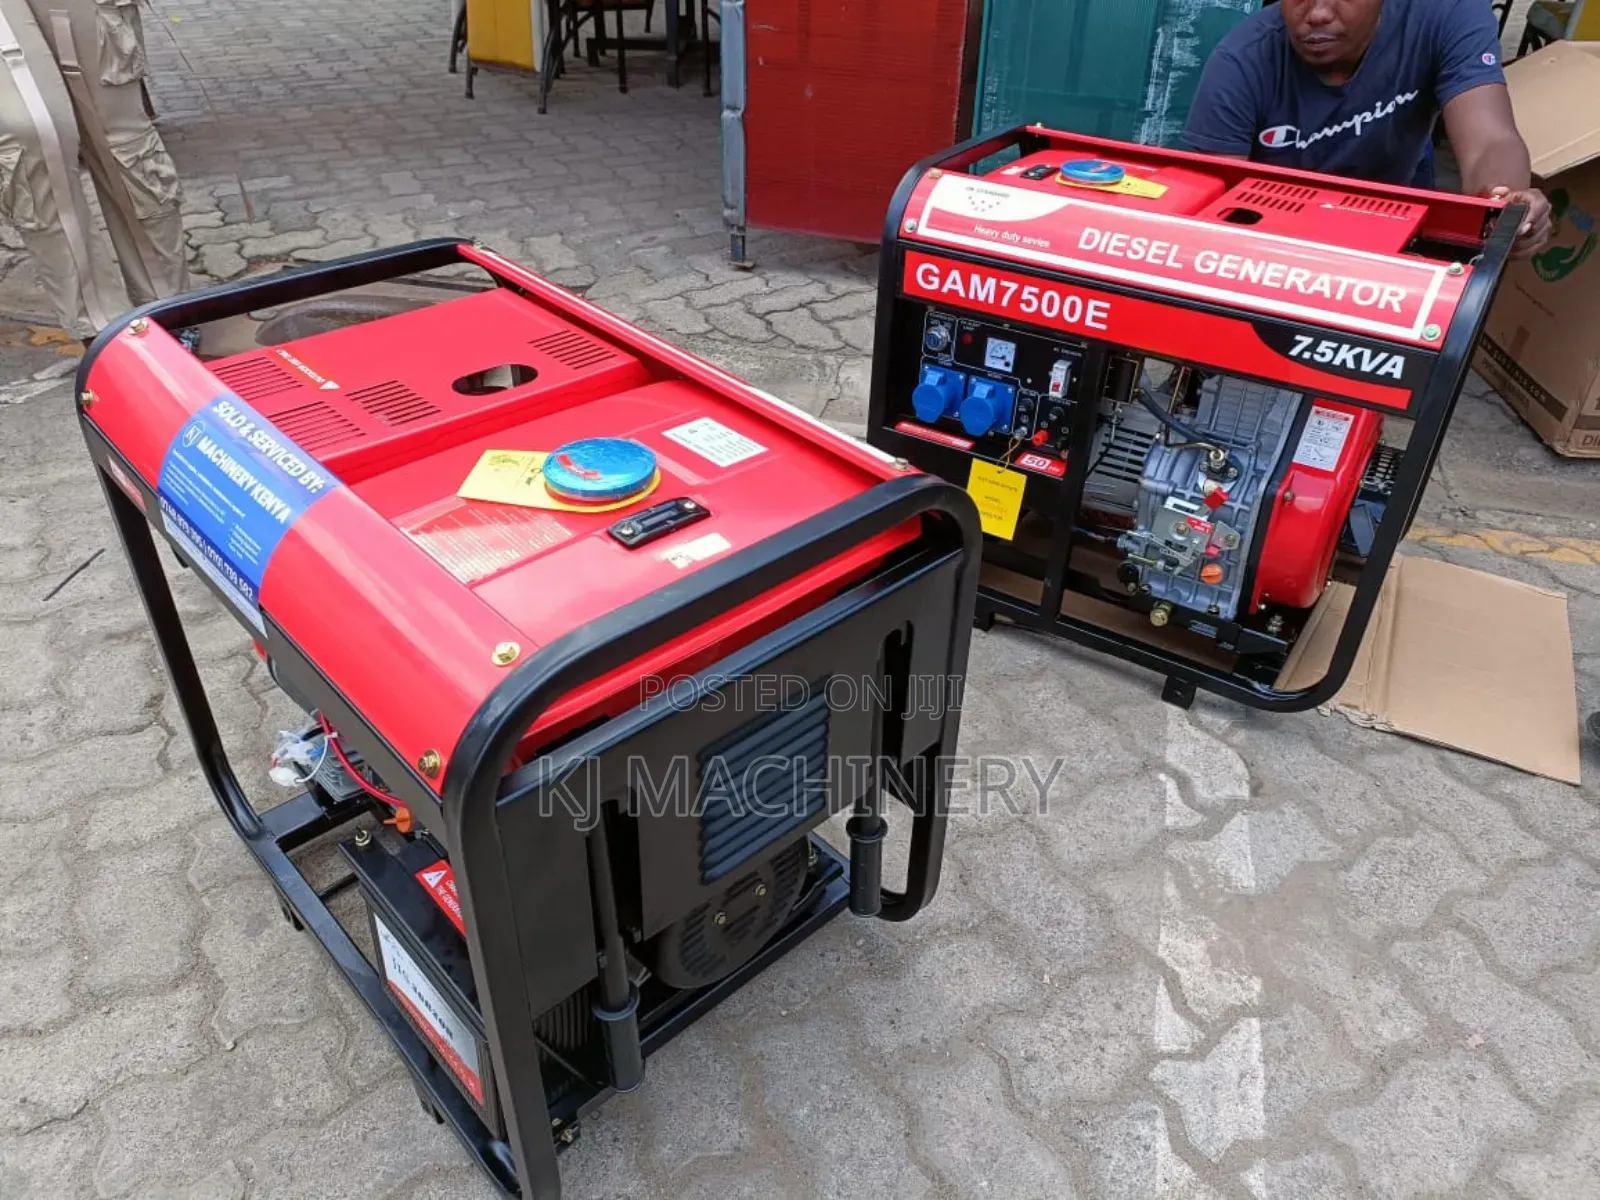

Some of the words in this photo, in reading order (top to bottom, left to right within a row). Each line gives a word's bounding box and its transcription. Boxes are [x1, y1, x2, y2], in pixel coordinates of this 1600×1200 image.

[1258, 89, 1419, 150] Champion
[974, 223, 999, 238] Heavy
[1001, 229, 1021, 243] duty
[915, 262, 1112, 330] GAM7500E
[1078, 227, 1184, 268] DIESEL
[1194, 250, 1407, 313] GENERATOR
[1288, 334, 1406, 379] 7.5KVA
[212, 400, 247, 428] SOLD
[238, 422, 256, 437] &
[247, 430, 307, 477] SERVICED
[297, 470, 326, 494] BY:
[1024, 456, 1047, 468] 50
[196, 436, 258, 491] MACHINERY
[250, 482, 292, 524] KENYA
